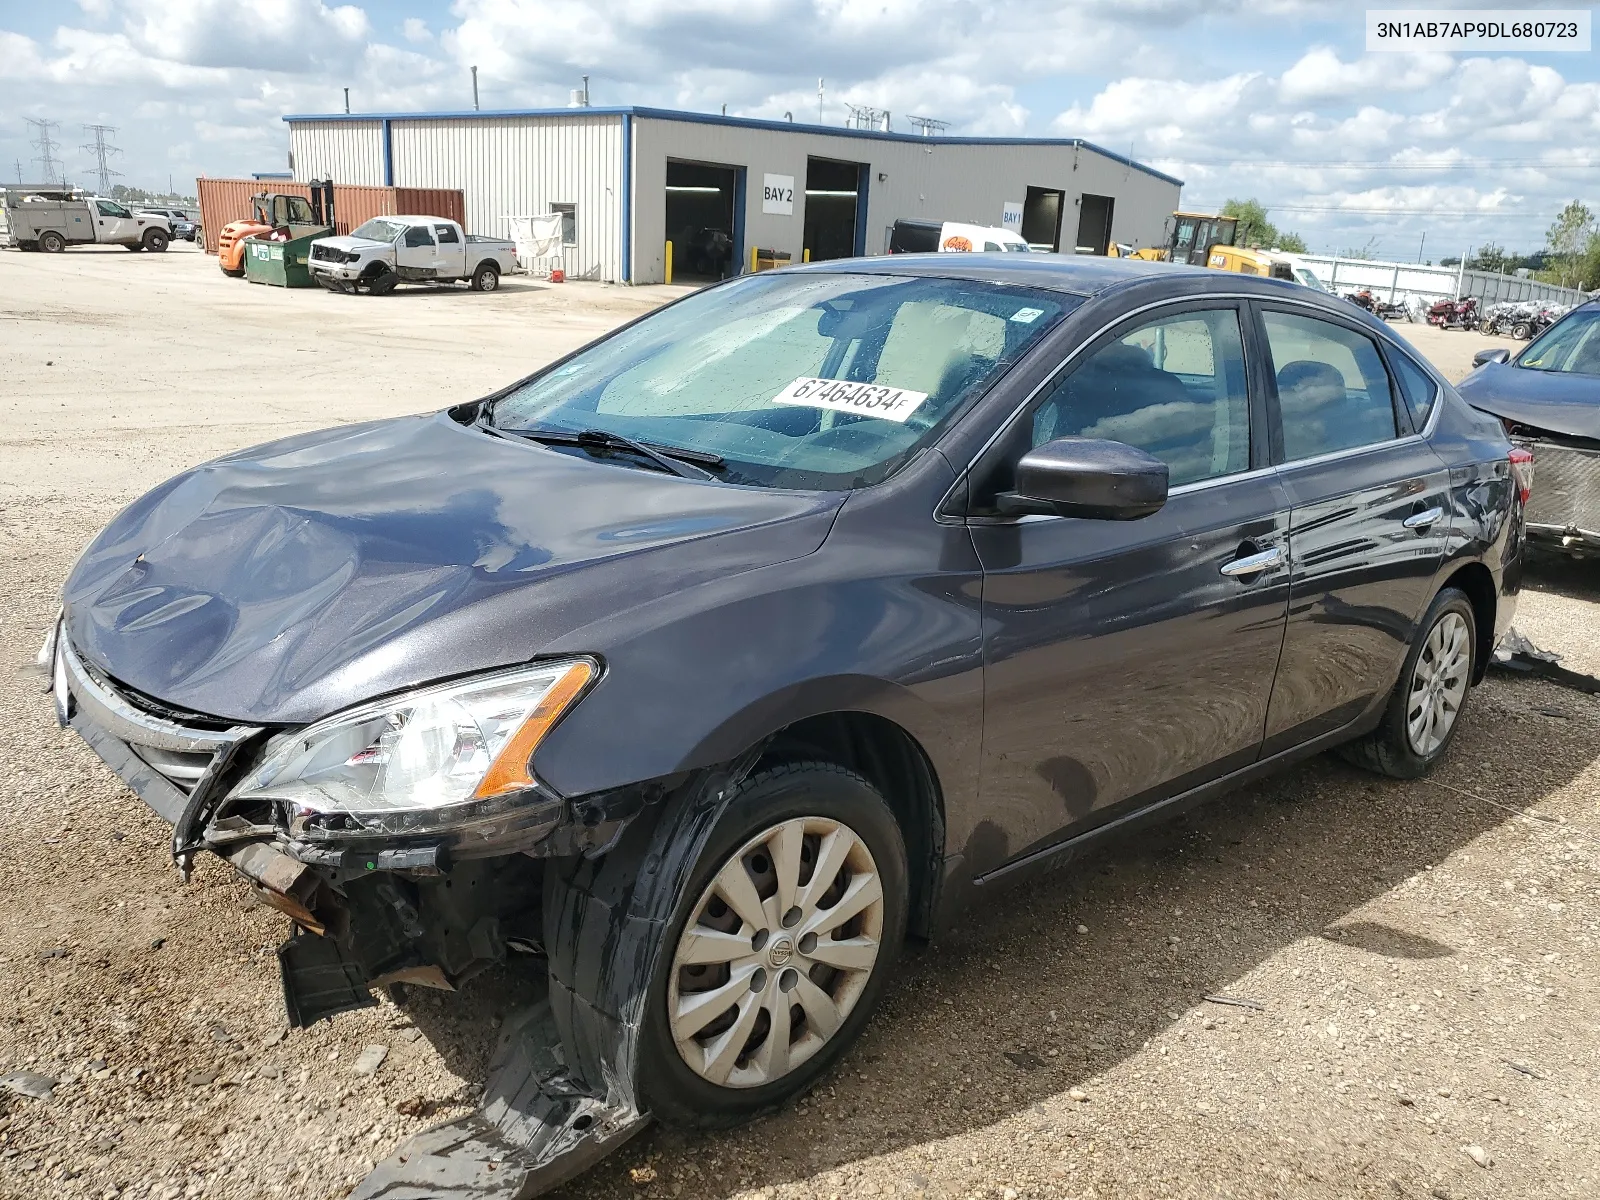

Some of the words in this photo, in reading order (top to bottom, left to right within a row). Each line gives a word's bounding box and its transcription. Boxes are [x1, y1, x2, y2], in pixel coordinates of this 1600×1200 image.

[764, 186, 785, 202] BAY
[786, 189, 793, 203] 2
[1004, 212, 1017, 223] BAY
